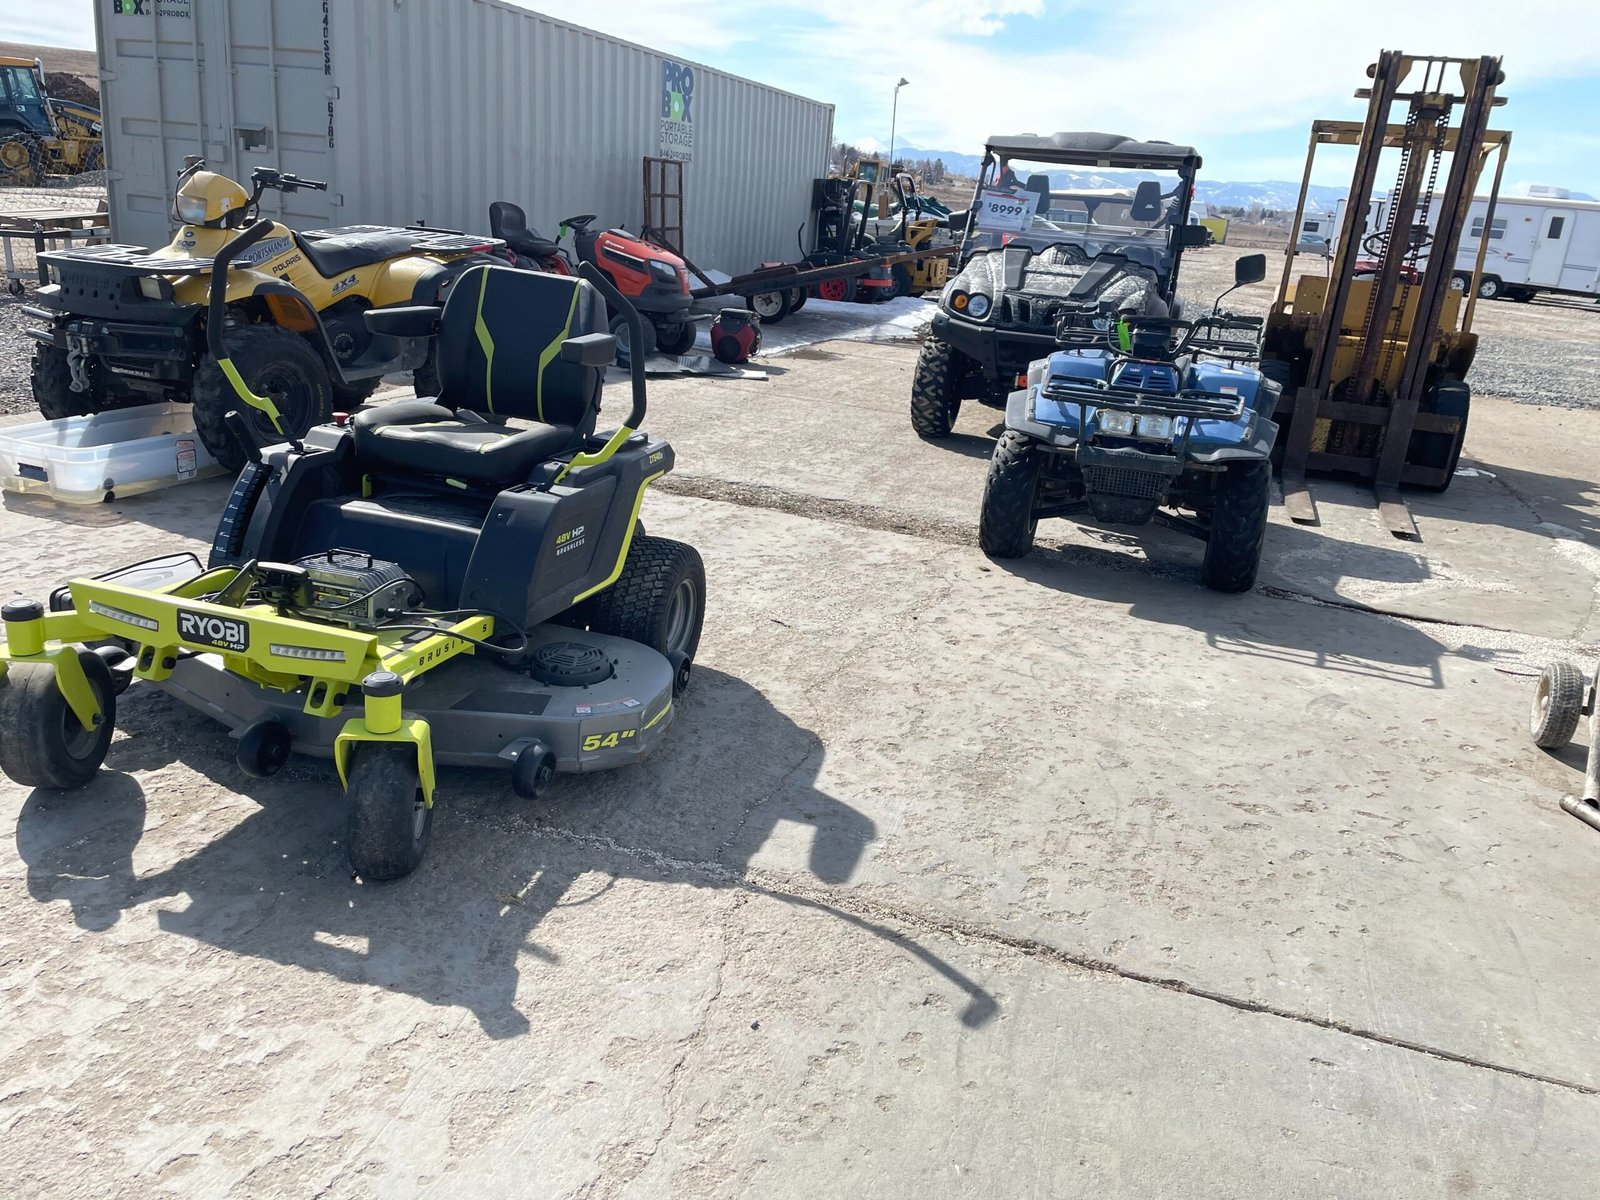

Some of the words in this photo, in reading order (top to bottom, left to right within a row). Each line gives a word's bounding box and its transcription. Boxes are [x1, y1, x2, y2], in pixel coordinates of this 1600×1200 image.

[113, 0, 145, 15] BOX
[662, 60, 694, 96] PRO
[661, 90, 693, 123] BOX
[660, 120, 693, 136] PORTABLE
[660, 132, 693, 147] STORAGE
[988, 202, 1023, 216] $8999
[243, 240, 283, 263] SPORTSMAN
[272, 254, 301, 274] POLARIS
[332, 274, 357, 292] 4X4
[555, 531, 571, 544] 48V
[572, 526, 585, 538] HP
[556, 538, 585, 556] BRUSHLESS
[180, 613, 245, 644] RYOBI
[582, 729, 636, 752] 54"
